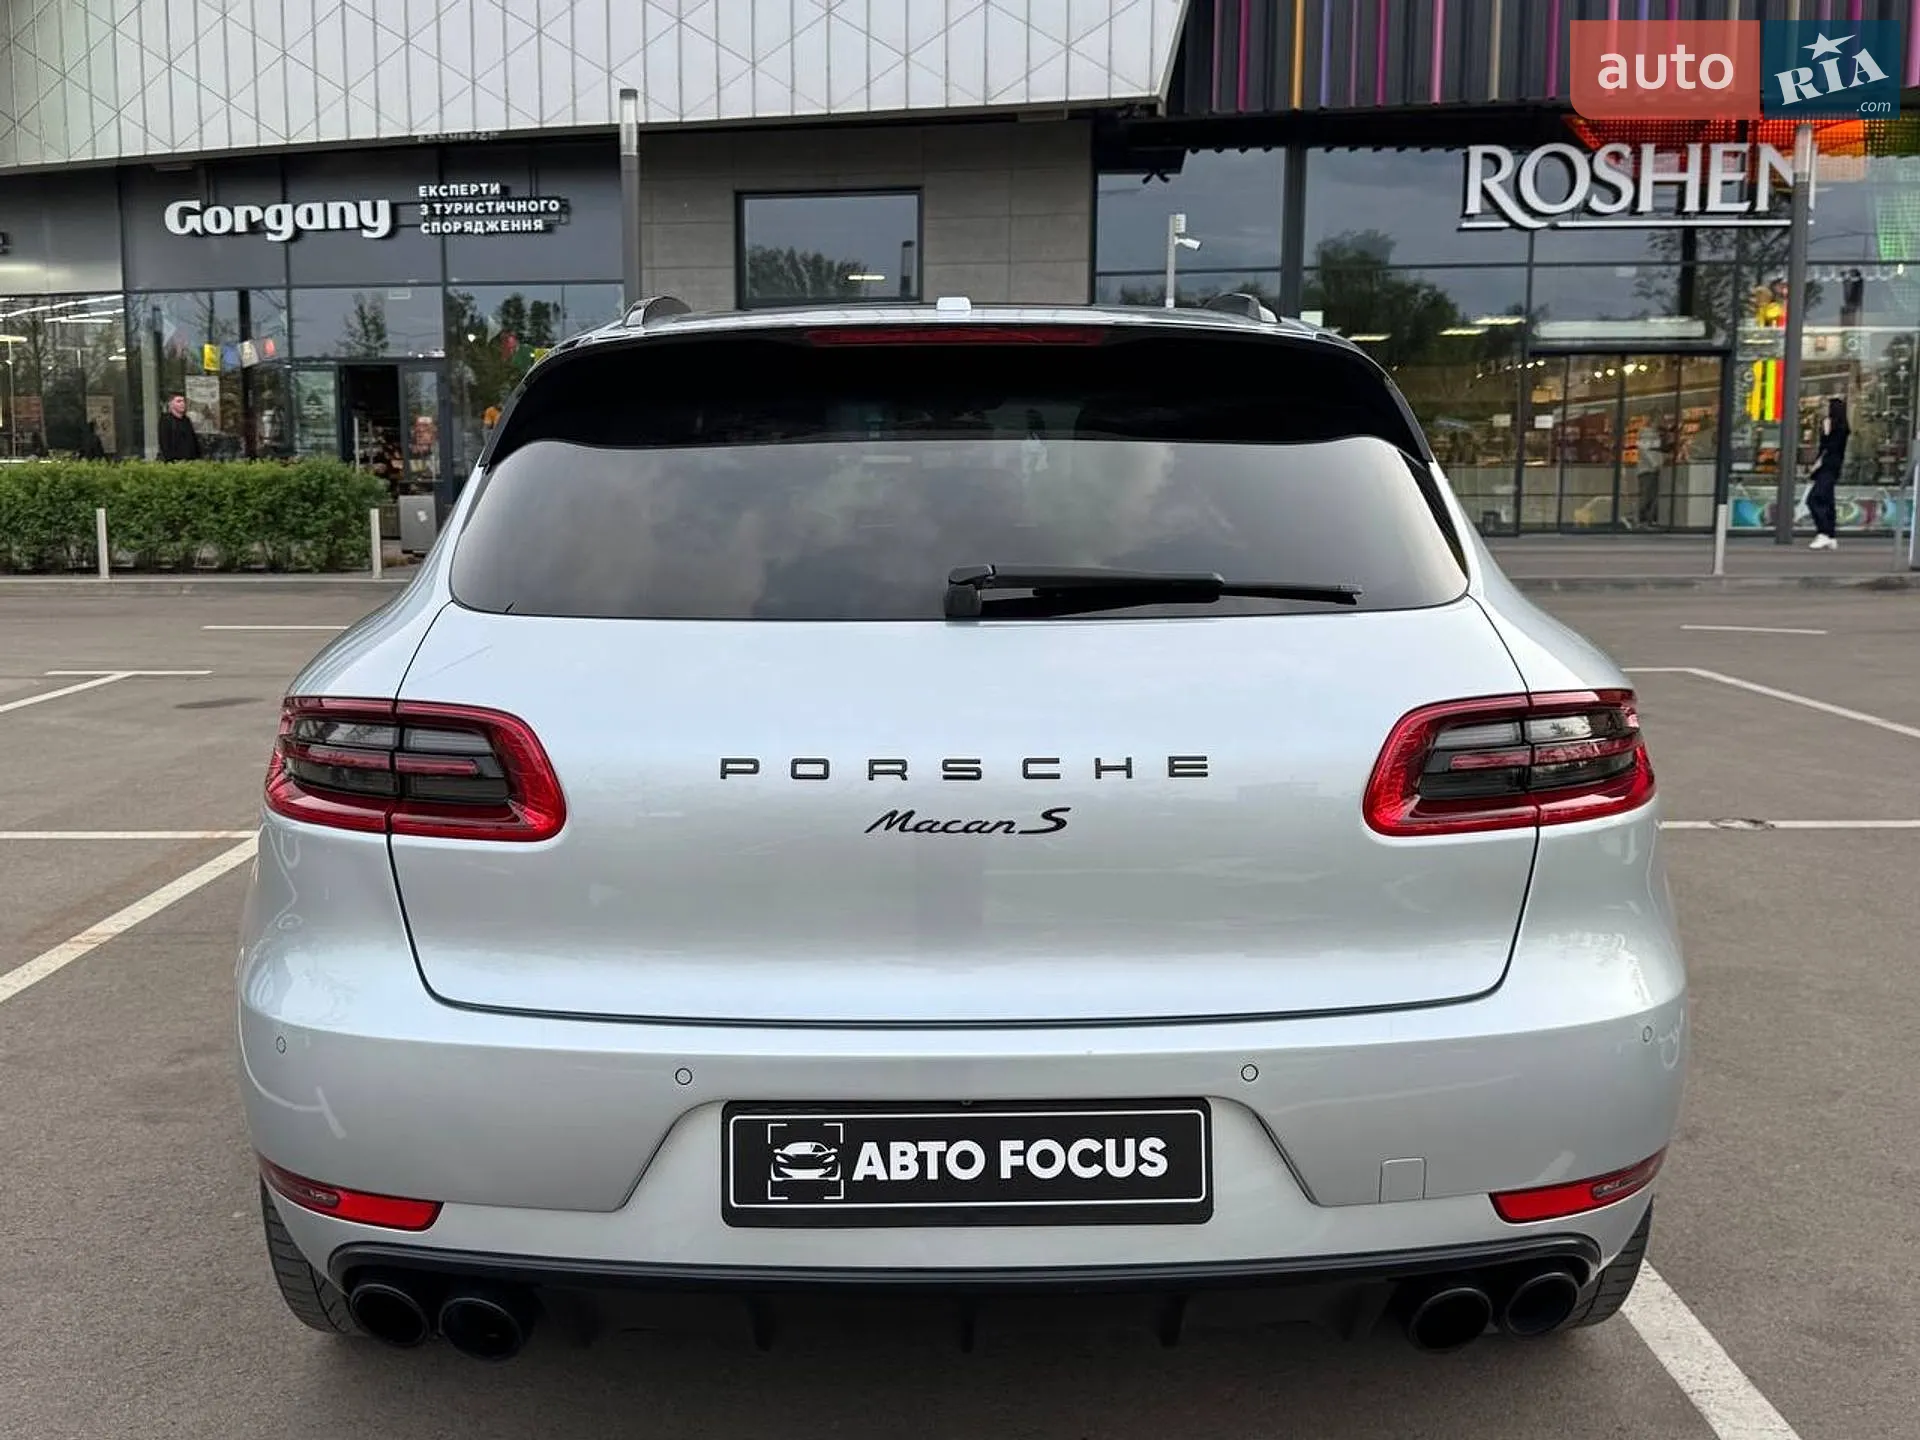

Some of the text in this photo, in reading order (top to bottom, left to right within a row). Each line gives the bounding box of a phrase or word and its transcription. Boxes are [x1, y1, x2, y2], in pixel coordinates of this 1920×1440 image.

[419, 183, 500, 197] ЕКСПЕРТИ
[434, 200, 560, 215] ТУРИСТИЧНОГО
[165, 200, 390, 241] Gorgany
[420, 219, 544, 234] СПОРЯДЖЕННЯ
[720, 756, 1208, 781] PORSCHE
[865, 807, 1071, 834] Macan S
[1000, 1137, 1168, 1179] FOCUS
